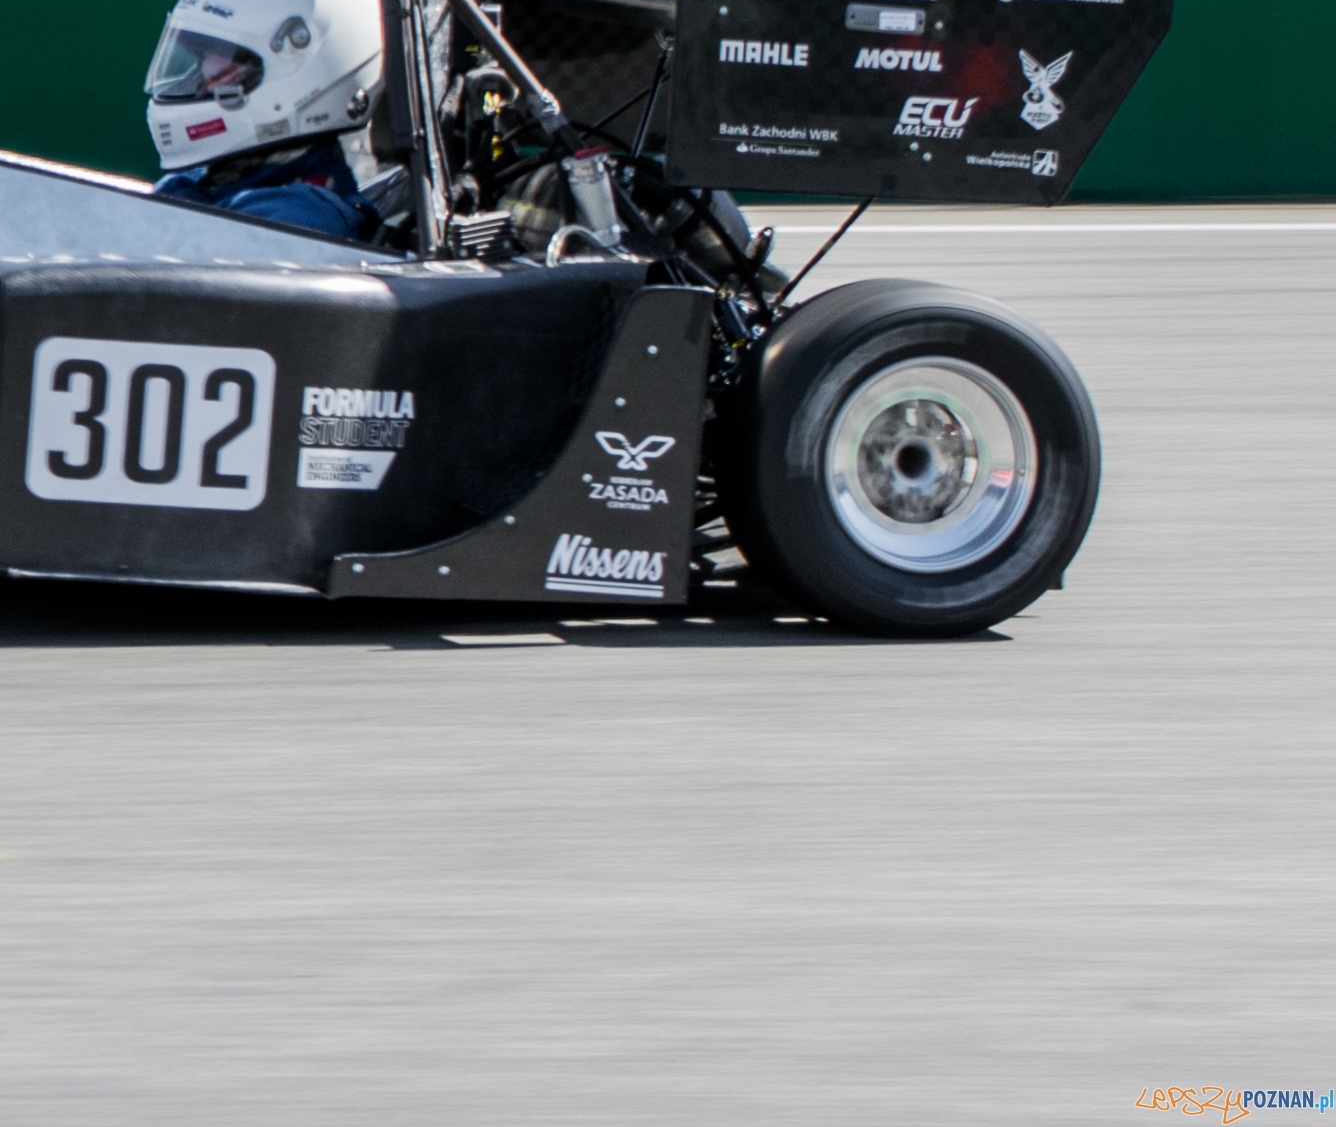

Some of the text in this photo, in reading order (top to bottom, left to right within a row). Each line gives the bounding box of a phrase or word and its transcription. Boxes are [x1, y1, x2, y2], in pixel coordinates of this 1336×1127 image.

[719, 39, 810, 68] MAHLE
[853, 46, 944, 73] MOTUL
[898, 95, 981, 129] ECU
[719, 122, 839, 142] Bank Zachodni WBK
[892, 124, 964, 140] MASTER
[302, 386, 415, 419] FORMULA
[47, 358, 256, 490] 302
[298, 416, 410, 449] STUDENT
[588, 483, 669, 504] ZASADA
[546, 533, 665, 583] Nissens
